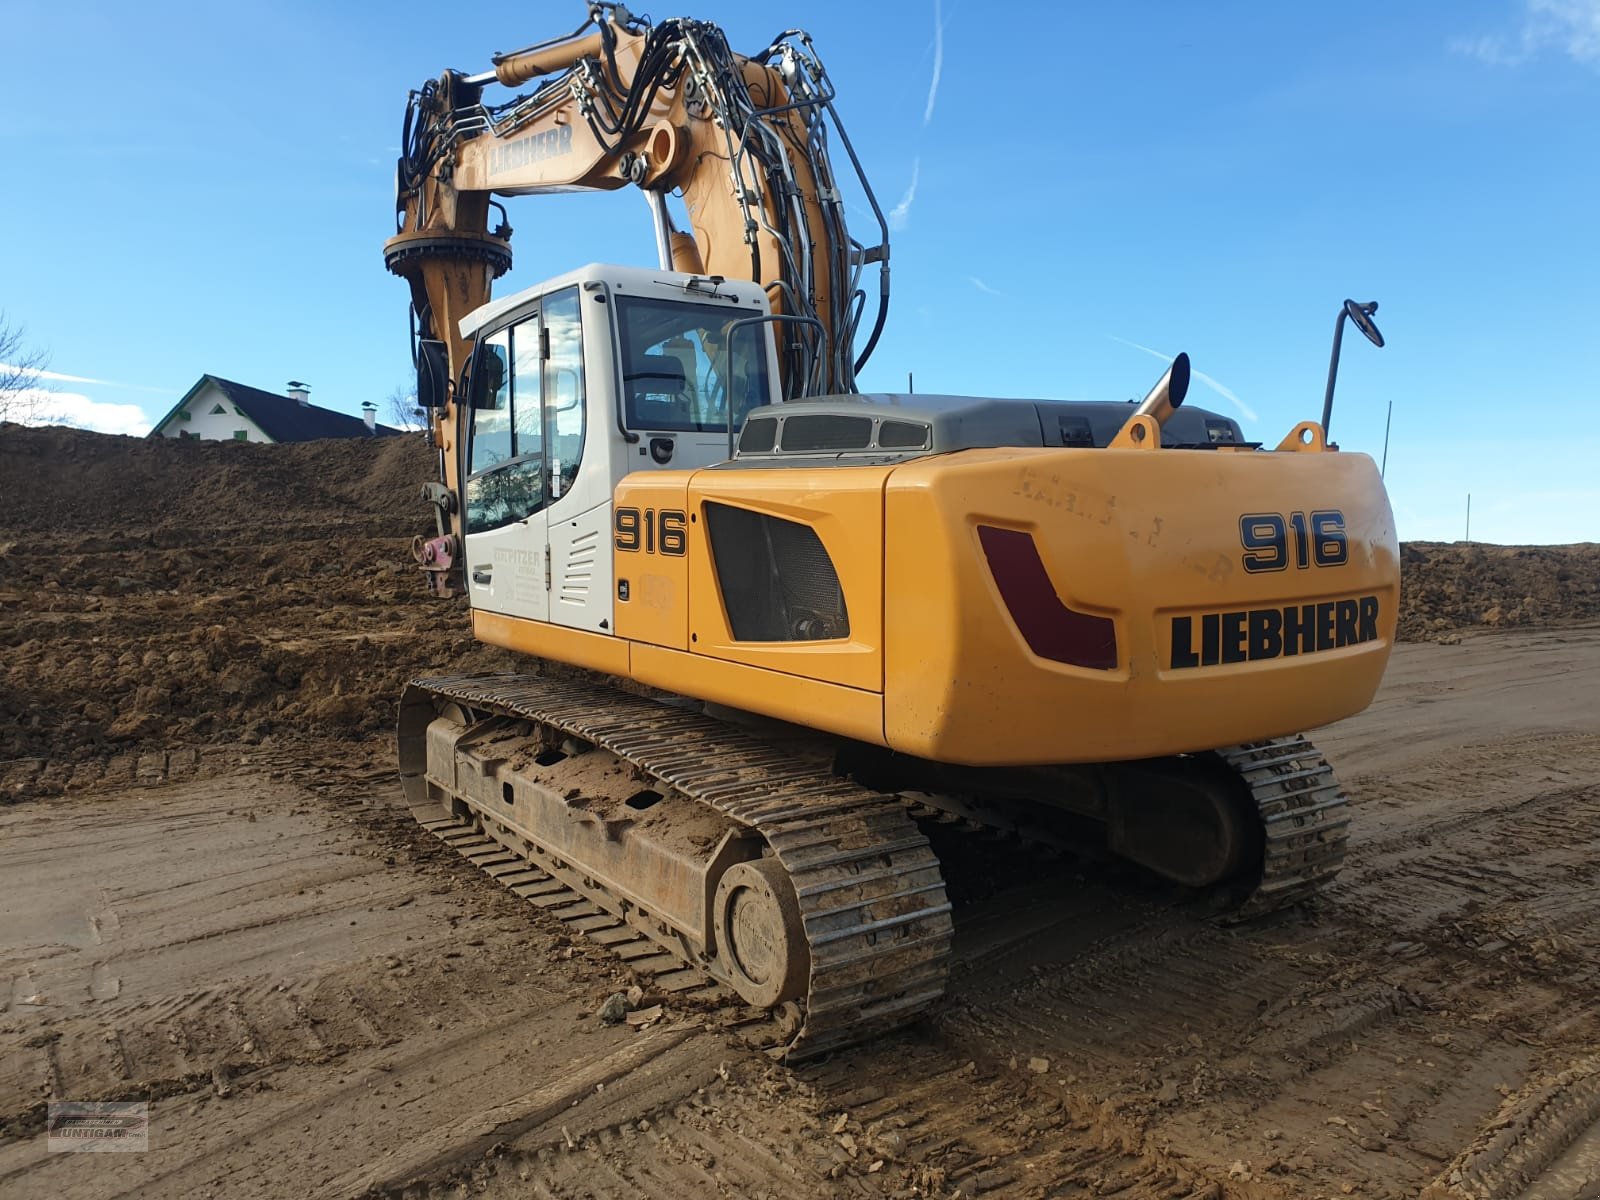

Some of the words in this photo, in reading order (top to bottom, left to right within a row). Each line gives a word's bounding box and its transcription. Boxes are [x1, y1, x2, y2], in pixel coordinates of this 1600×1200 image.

[490, 126, 572, 176] LIEBHERR
[615, 507, 687, 556] 916
[1238, 509, 1349, 574] 916
[1170, 596, 1379, 669] LIEBHERR
